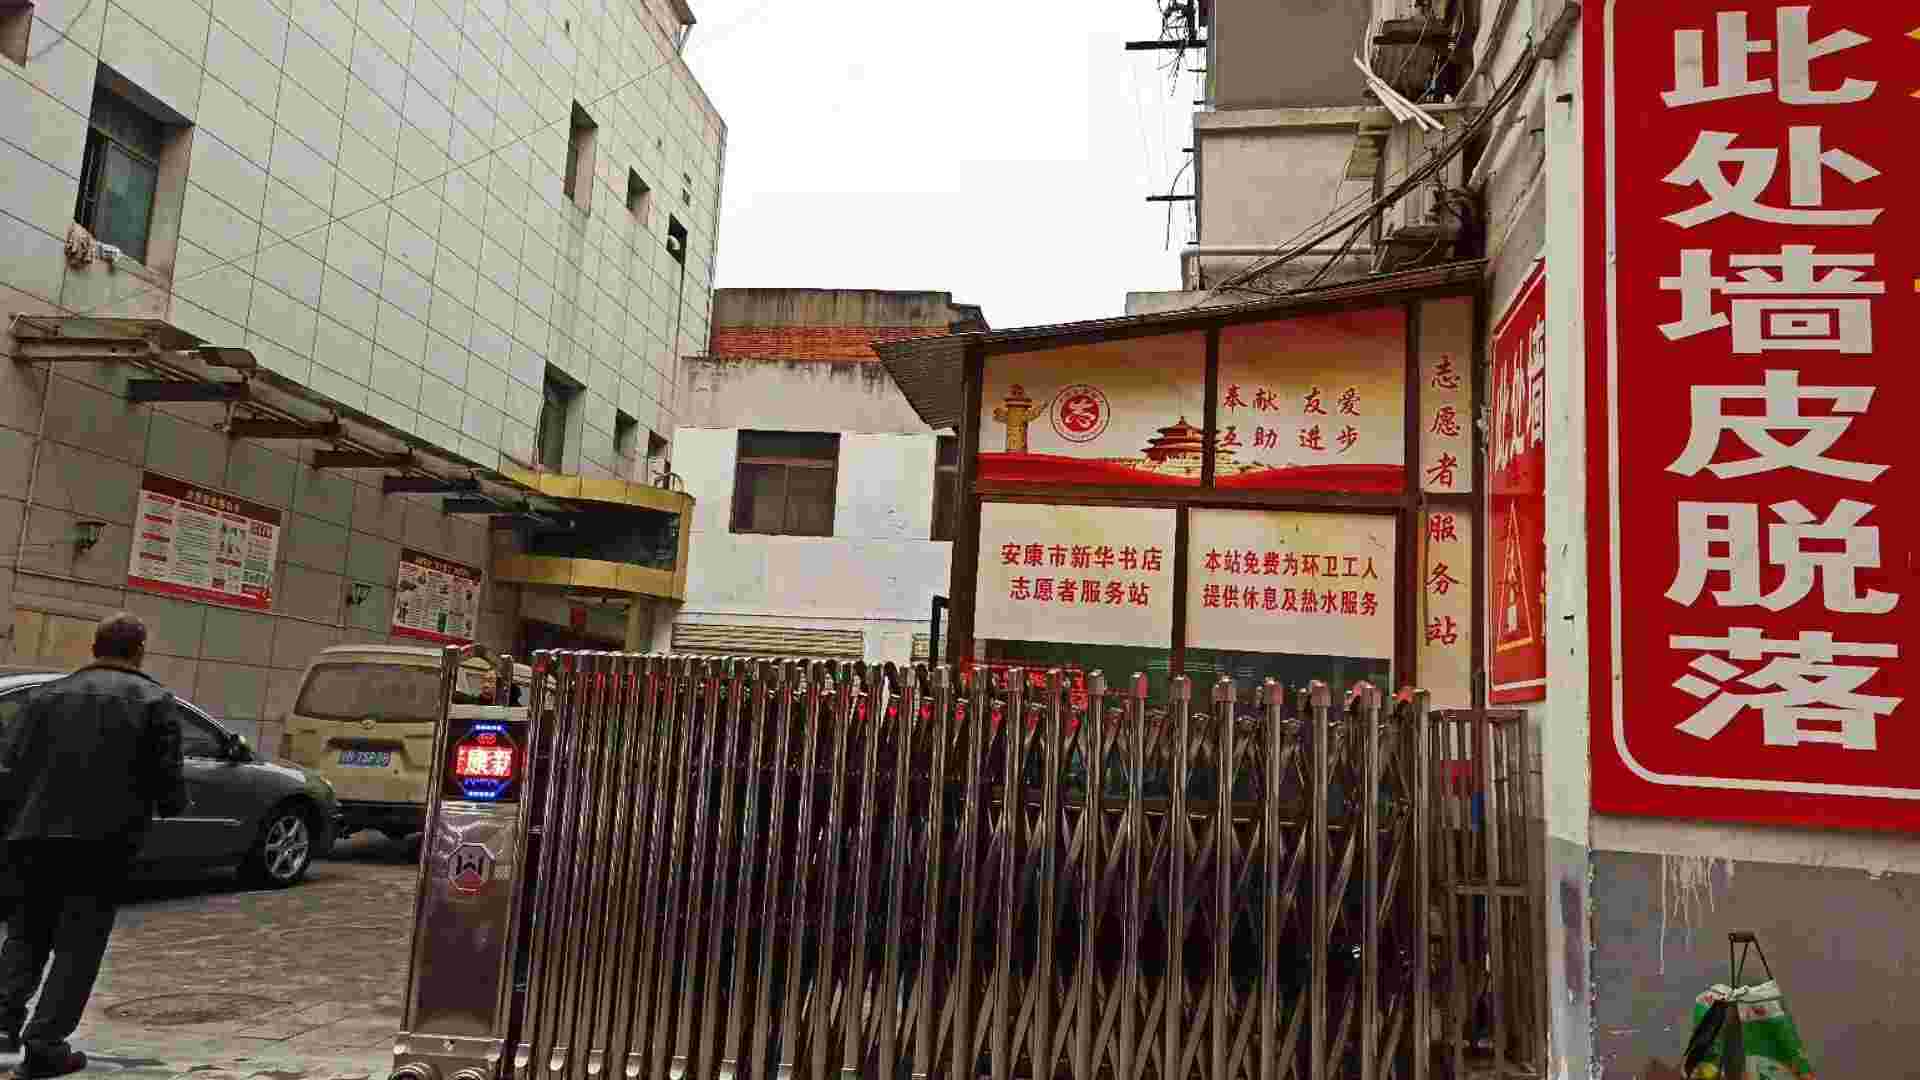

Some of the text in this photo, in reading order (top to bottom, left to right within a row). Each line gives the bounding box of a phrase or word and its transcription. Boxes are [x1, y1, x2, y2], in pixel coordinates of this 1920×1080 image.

[1659, 5, 1905, 752] 此处墙皮脱落
[1223, 384, 1361, 416] 奉献 友爱
[1220, 423, 1360, 456] 互助 进步
[1424, 354, 1464, 647] 志愿者服务站
[1000, 542, 1163, 572] 安康市新华书店
[1204, 547, 1378, 580] 本站免费为环卫工人
[1008, 575, 1151, 606] 志愿者服务站
[1202, 582, 1378, 616] 提供休息及热水服务
